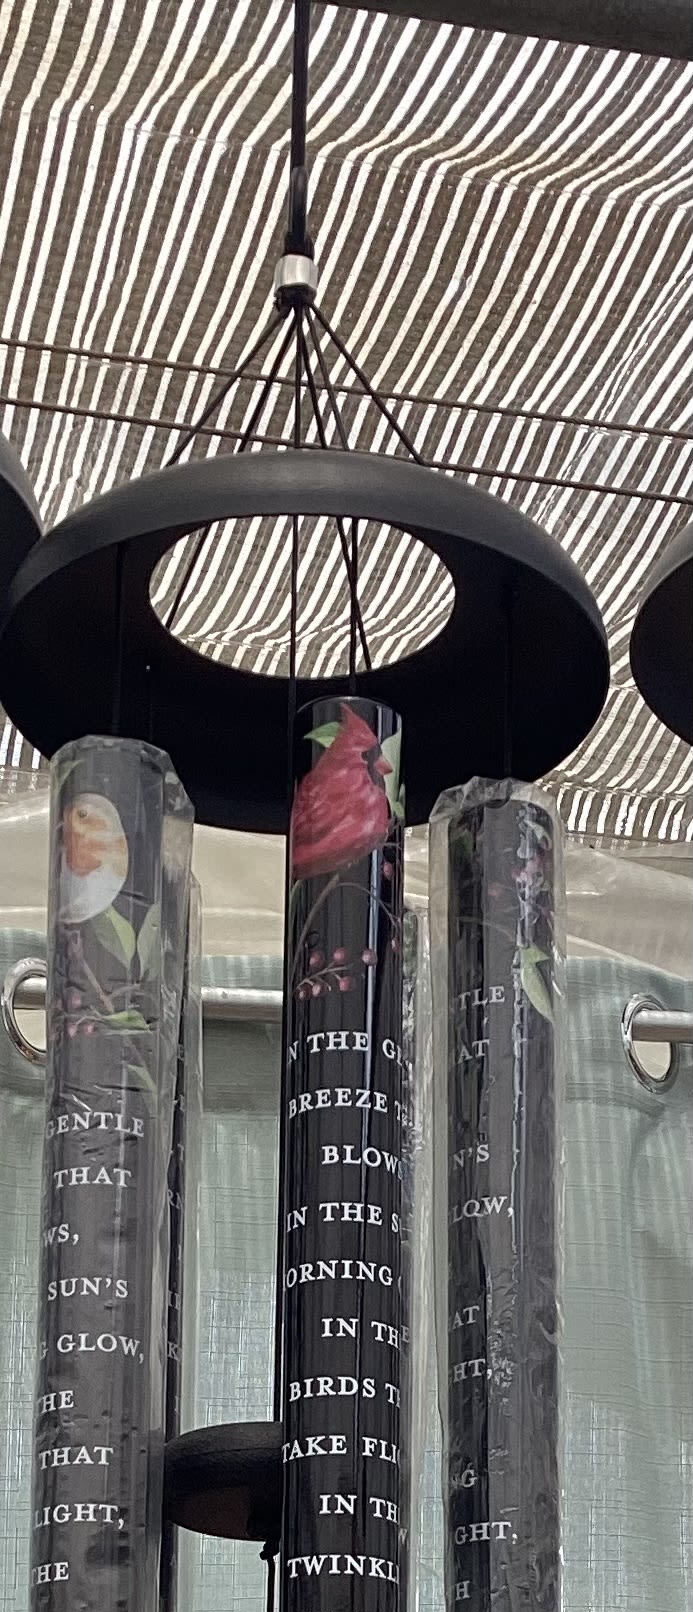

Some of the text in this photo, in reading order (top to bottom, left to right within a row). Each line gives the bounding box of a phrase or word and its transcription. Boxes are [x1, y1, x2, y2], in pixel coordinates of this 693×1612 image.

[306, 1030, 370, 1053] THE
[288, 1087, 388, 1119] BREEZE
[46, 1111, 144, 1139] GENTLE
[54, 1167, 131, 1189] THAT
[286, 1207, 308, 1232] IN
[319, 1202, 383, 1226] THE
[47, 1277, 129, 1301] SUN'S
[321, 1318, 359, 1338] IN
[57, 1333, 144, 1364] GLOW,
[289, 1376, 376, 1402] BIRDS
[38, 1446, 114, 1470] THAT
[281, 1434, 400, 1465] TAKE FLI
[319, 1494, 357, 1515] IN
